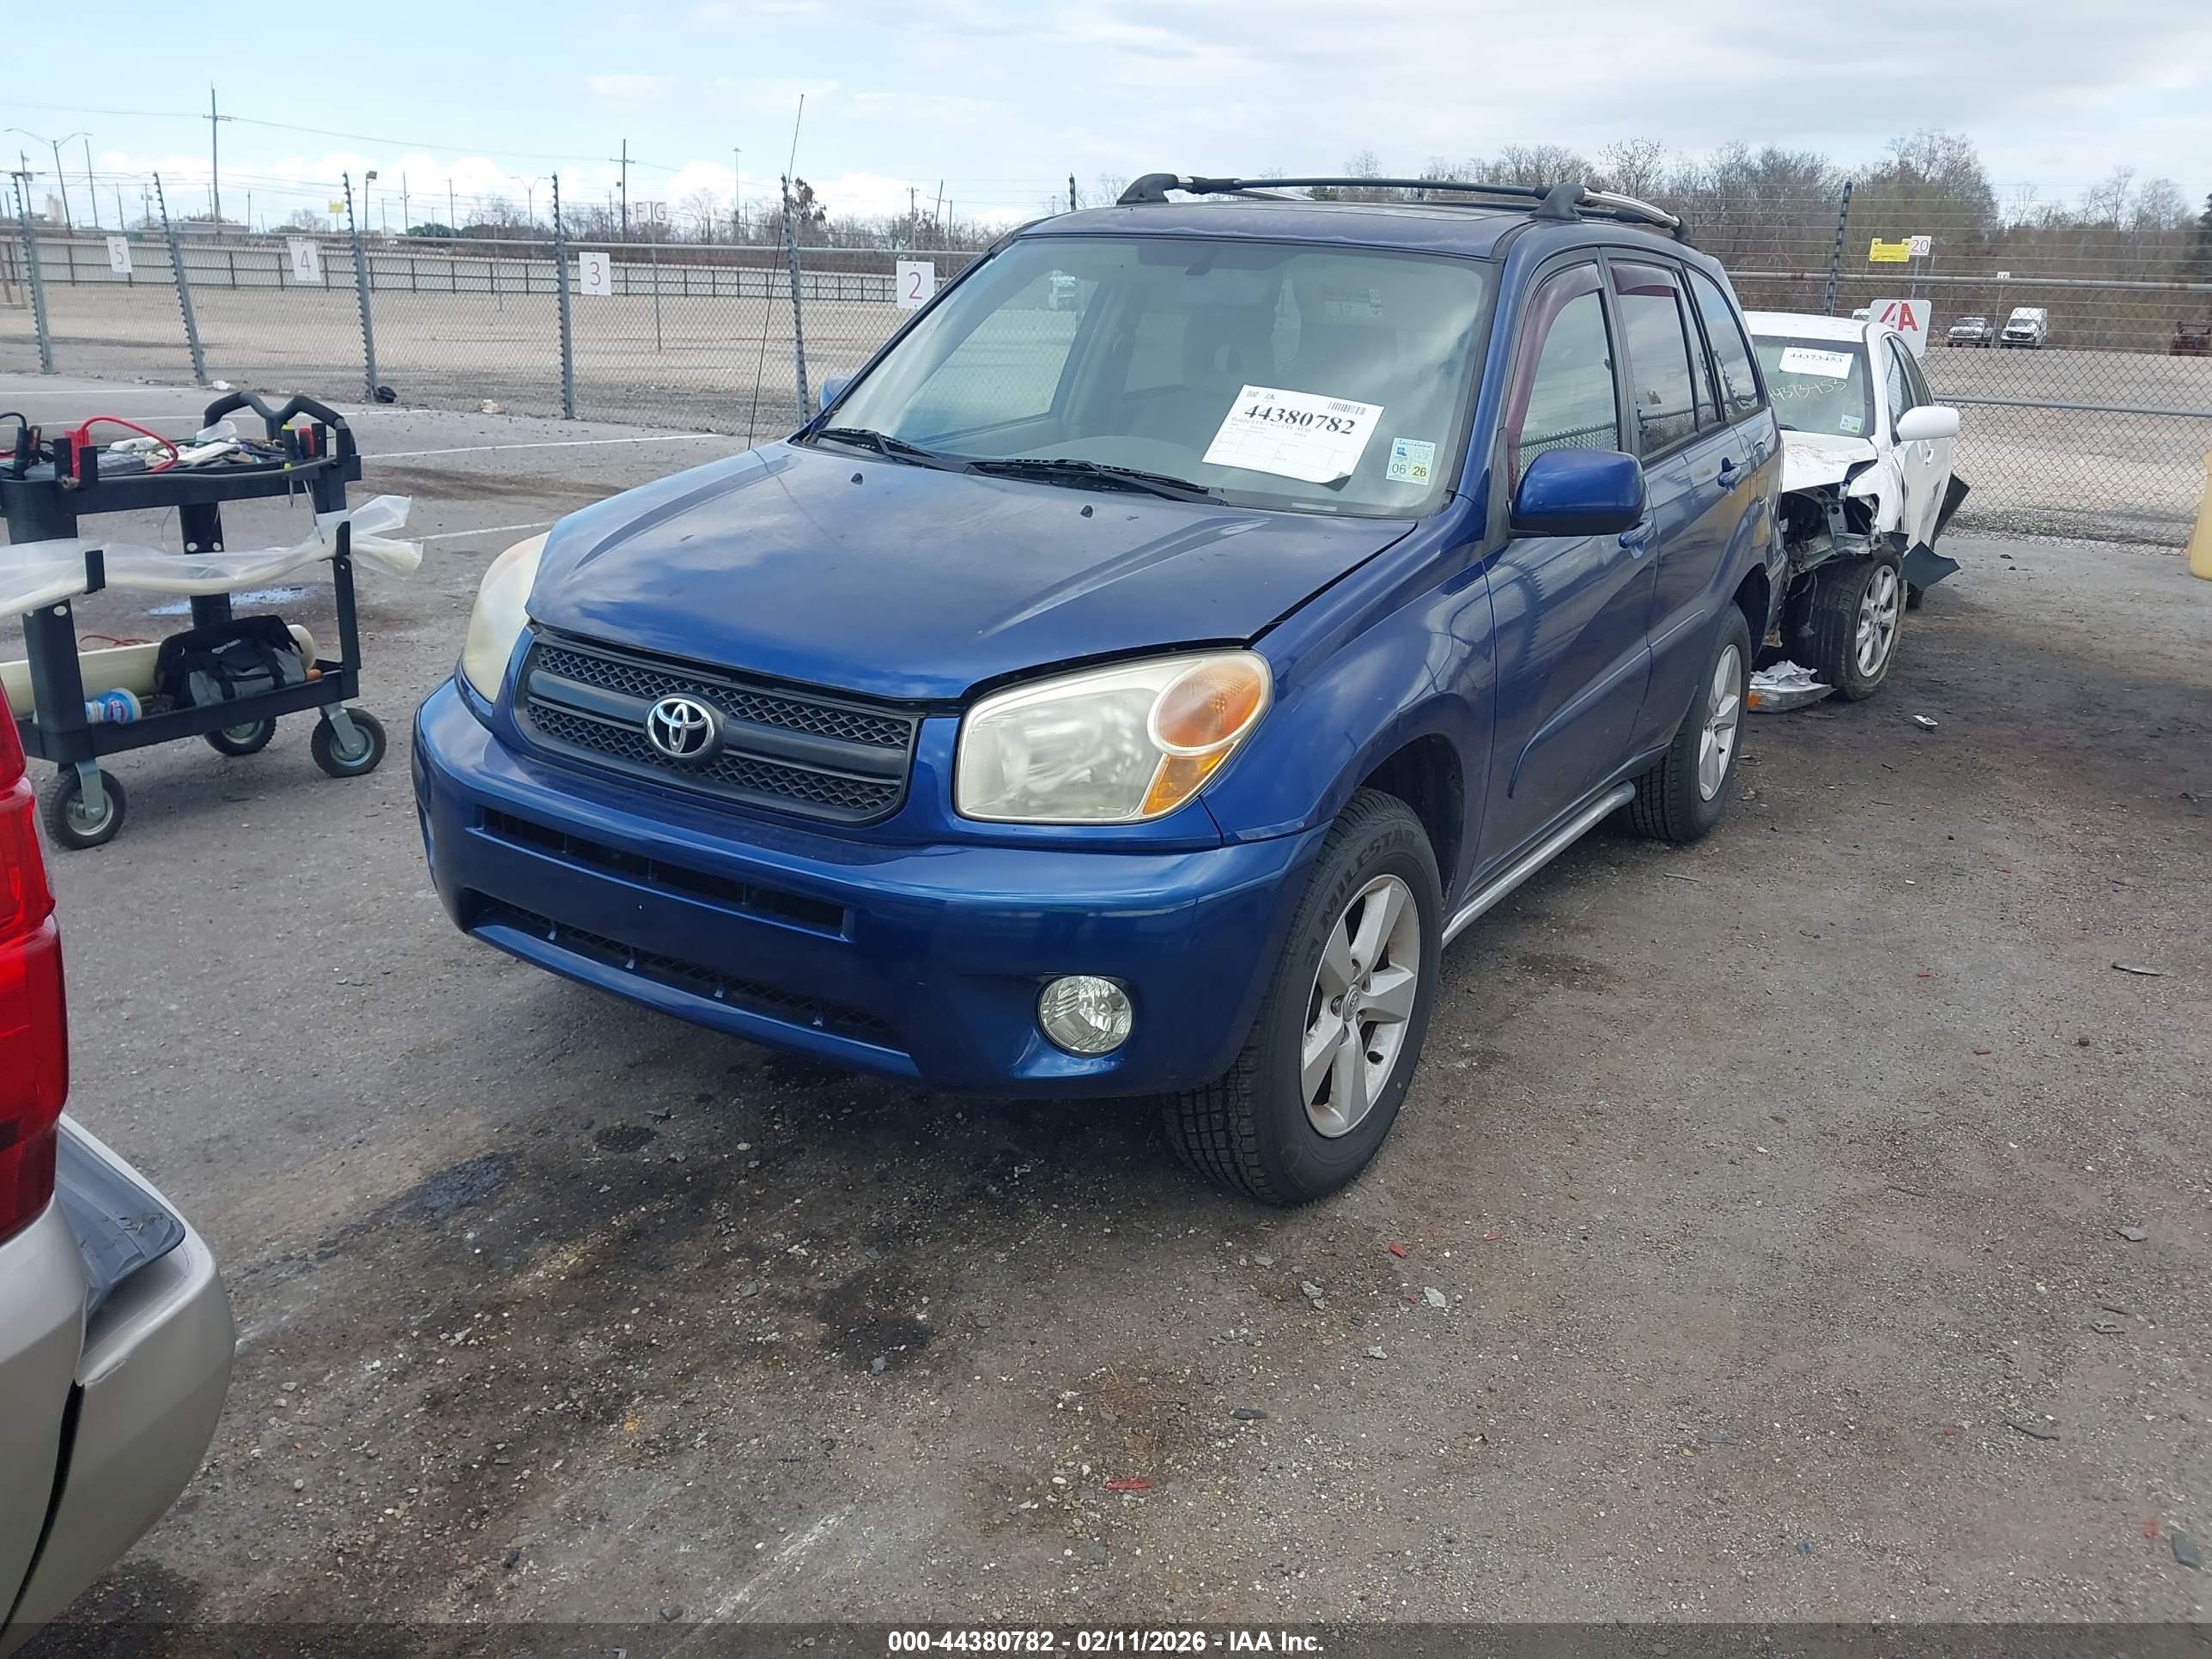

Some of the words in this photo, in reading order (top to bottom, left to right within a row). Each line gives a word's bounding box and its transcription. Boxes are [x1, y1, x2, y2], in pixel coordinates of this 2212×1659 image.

[114, 244, 125, 264] 5
[1910, 240, 1929, 252] 20
[301, 250, 311, 272] 4
[590, 261, 601, 286] 3
[908, 271, 922, 300] 2
[1243, 405, 1356, 435] 44380782
[1391, 463, 1407, 475] 06
[1413, 465, 1427, 477] 26
